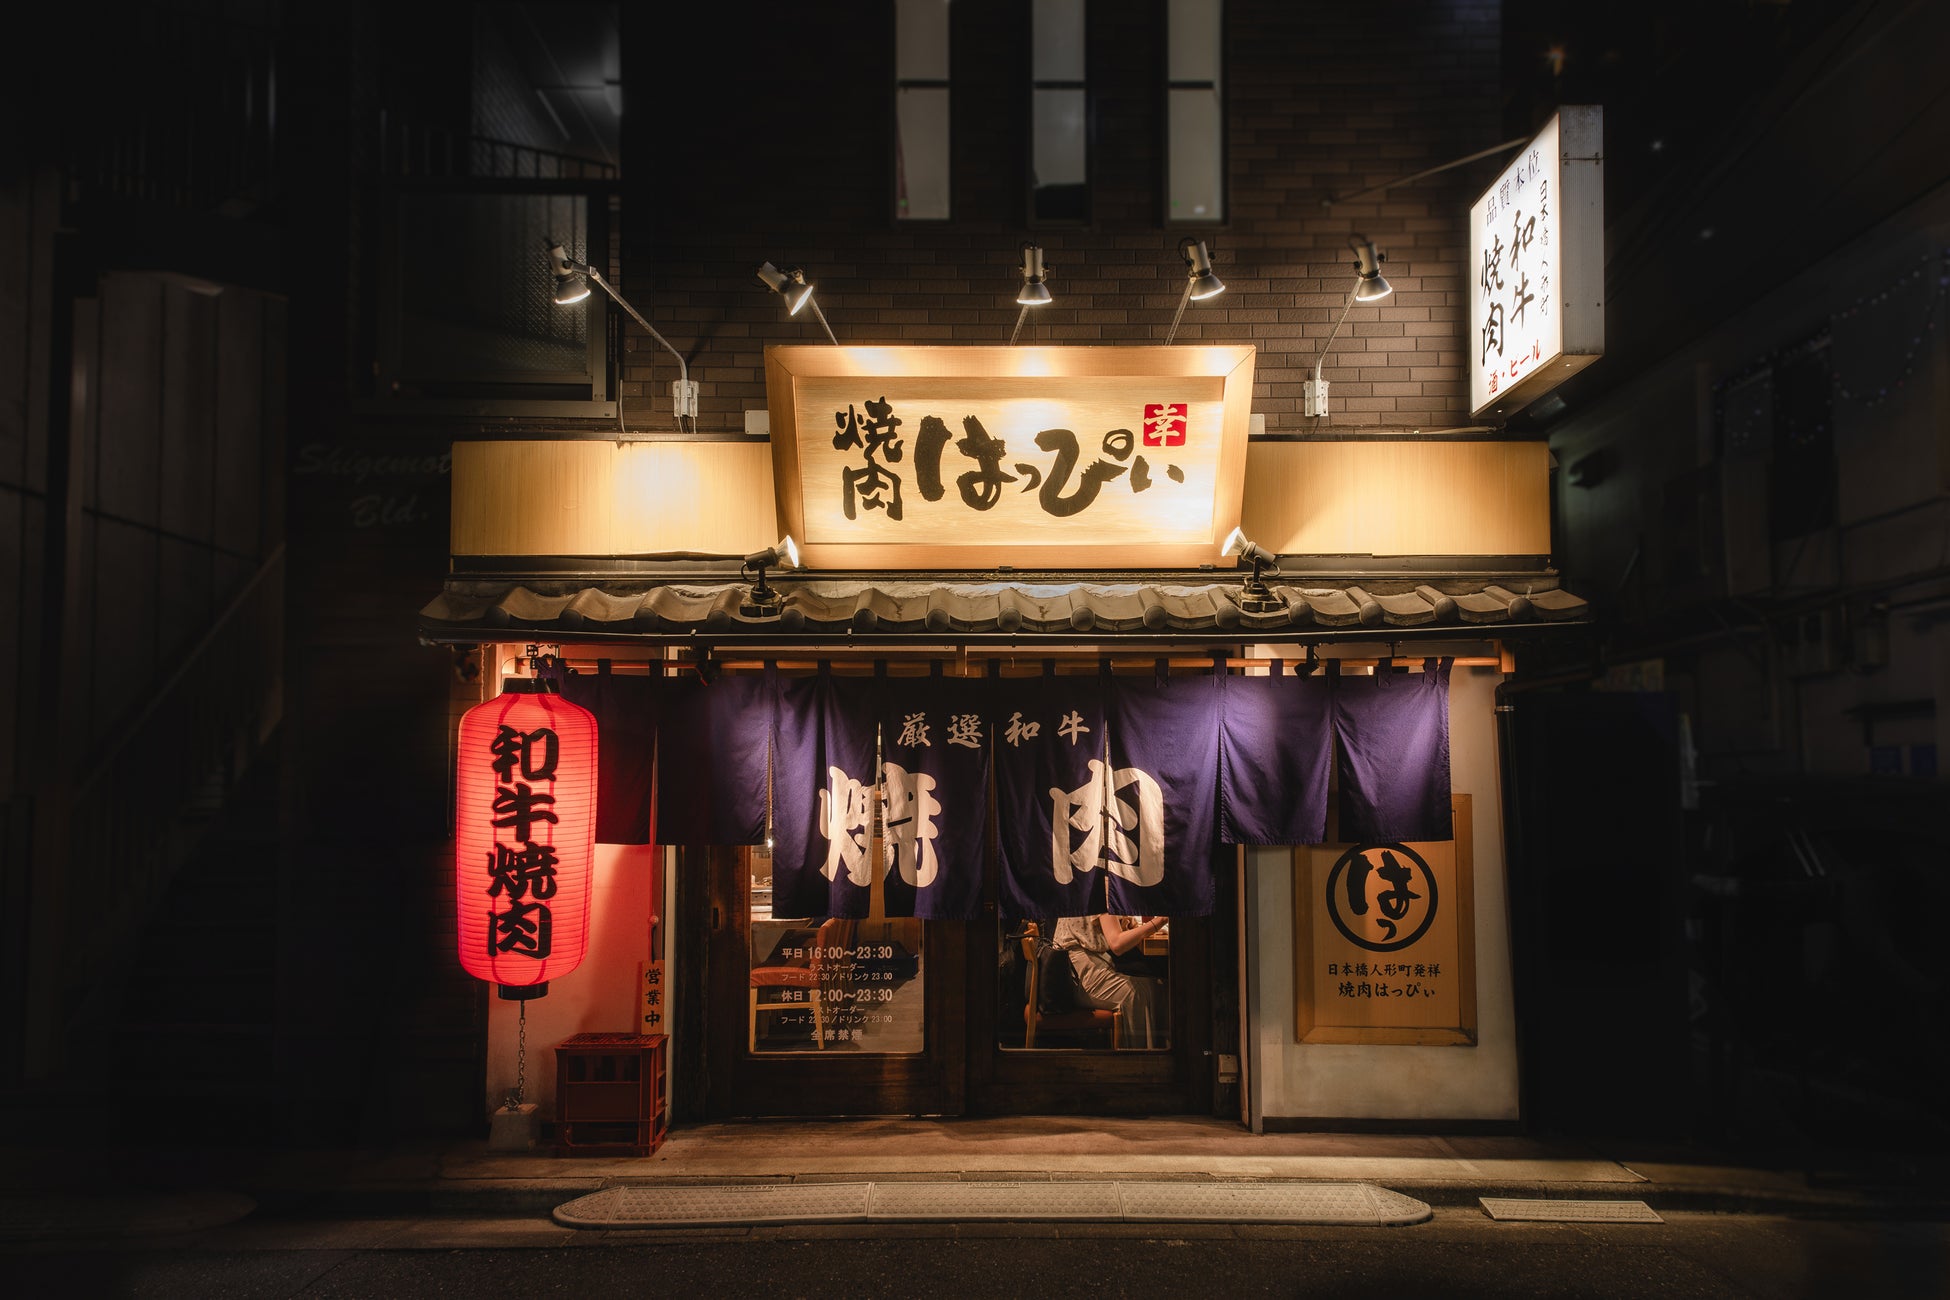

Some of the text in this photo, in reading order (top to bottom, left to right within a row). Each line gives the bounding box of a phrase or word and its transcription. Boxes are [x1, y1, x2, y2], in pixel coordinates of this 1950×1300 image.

[1486, 148, 1541, 228] 品質本位
[1509, 209, 1536, 329] 和牛
[1480, 233, 1504, 367] 焼肉
[1143, 403, 1188, 447] 幸
[833, 396, 904, 521] 焼肉
[897, 710, 1091, 749] 厳選和牛
[486, 723, 559, 961] 和牛焼肉
[818, 759, 1165, 888] 焼肉
[781, 946, 893, 960] 平日 16:00～23:30
[809, 963, 865, 972] ラストオーダー
[1327, 963, 1441, 978] 日本橋人形町発祥
[781, 973, 805, 981] フード
[781, 988, 893, 1002] 休日 12:00～23:30
[645, 968, 662, 1028] 営業中
[781, 1015, 805, 1024] フード
[810, 1028, 863, 1041] 全席禁煙
